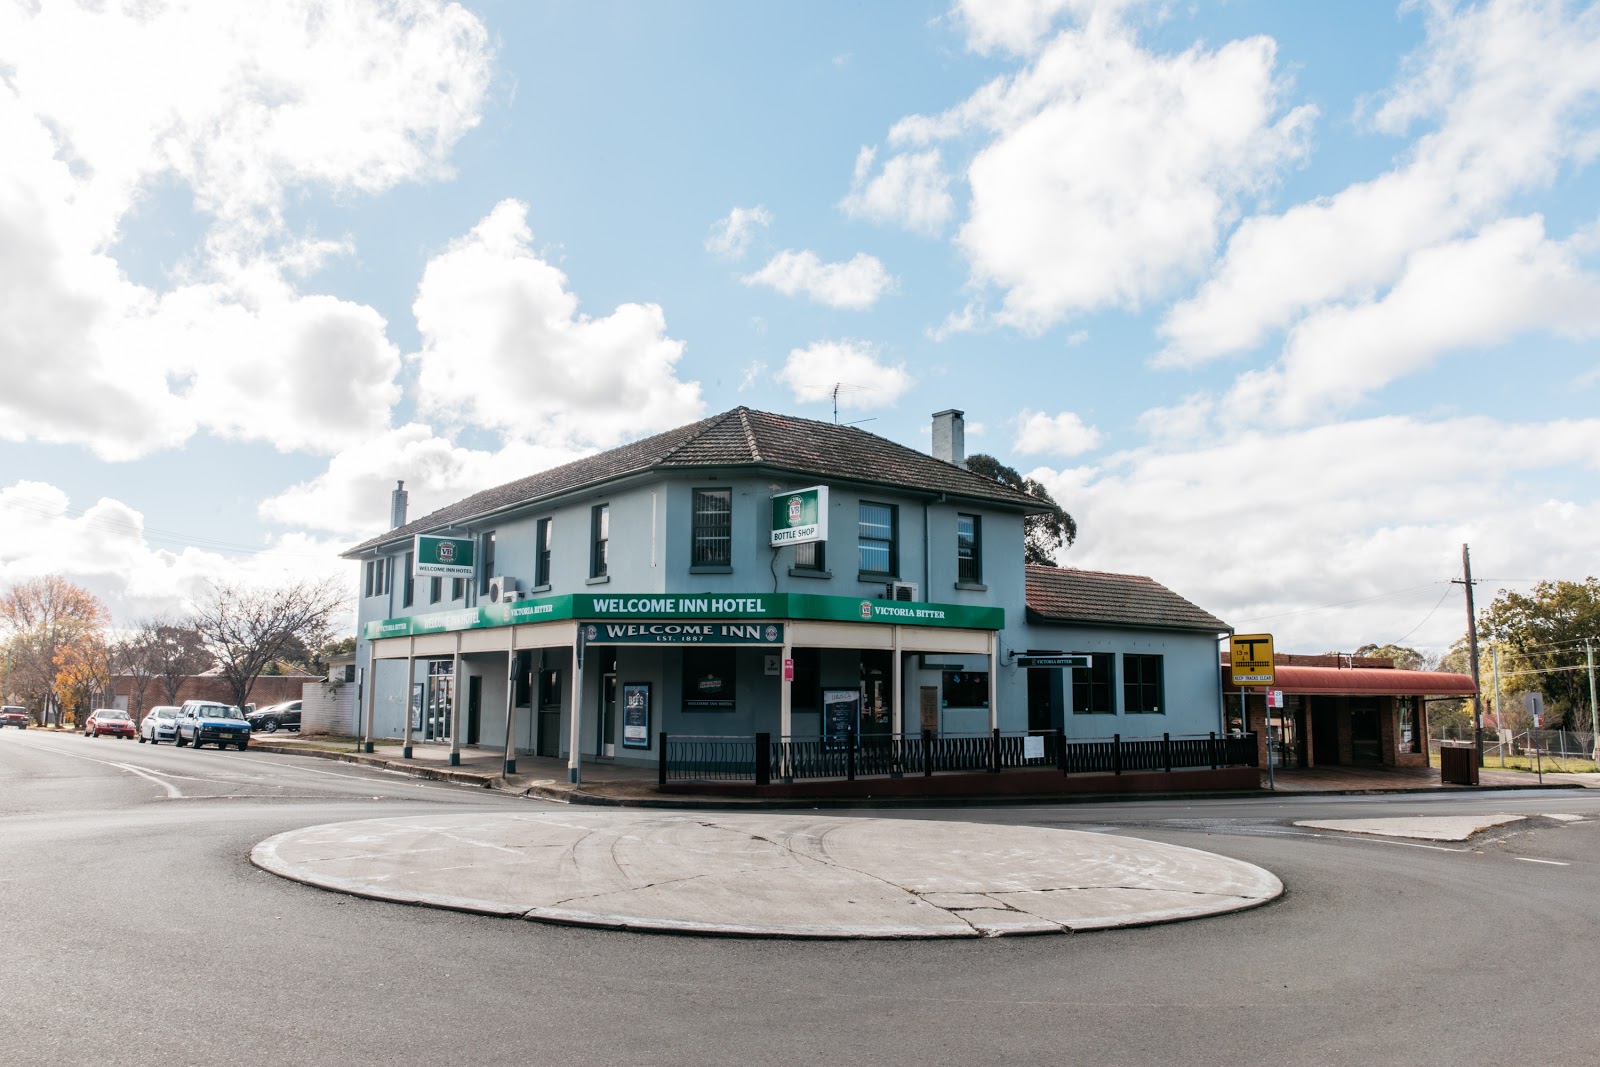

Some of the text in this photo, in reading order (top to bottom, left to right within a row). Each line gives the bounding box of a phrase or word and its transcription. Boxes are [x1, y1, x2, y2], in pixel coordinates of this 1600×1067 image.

[790, 505, 800, 515] VB
[774, 527, 815, 541] BOTTLE SHOP
[441, 548, 453, 556] VB
[419, 565, 445, 573] WELCOME
[511, 606, 533, 617] VICTORIA
[533, 604, 553, 614] BITTER
[593, 598, 766, 613] WELCOME INN HOTEL
[874, 606, 915, 617] VICTORIA
[915, 609, 945, 619] BITTER
[424, 615, 450, 629] WELCOME
[462, 612, 480, 625] HOTEL
[606, 624, 714, 639] WELCOME
[721, 625, 761, 640] INN
